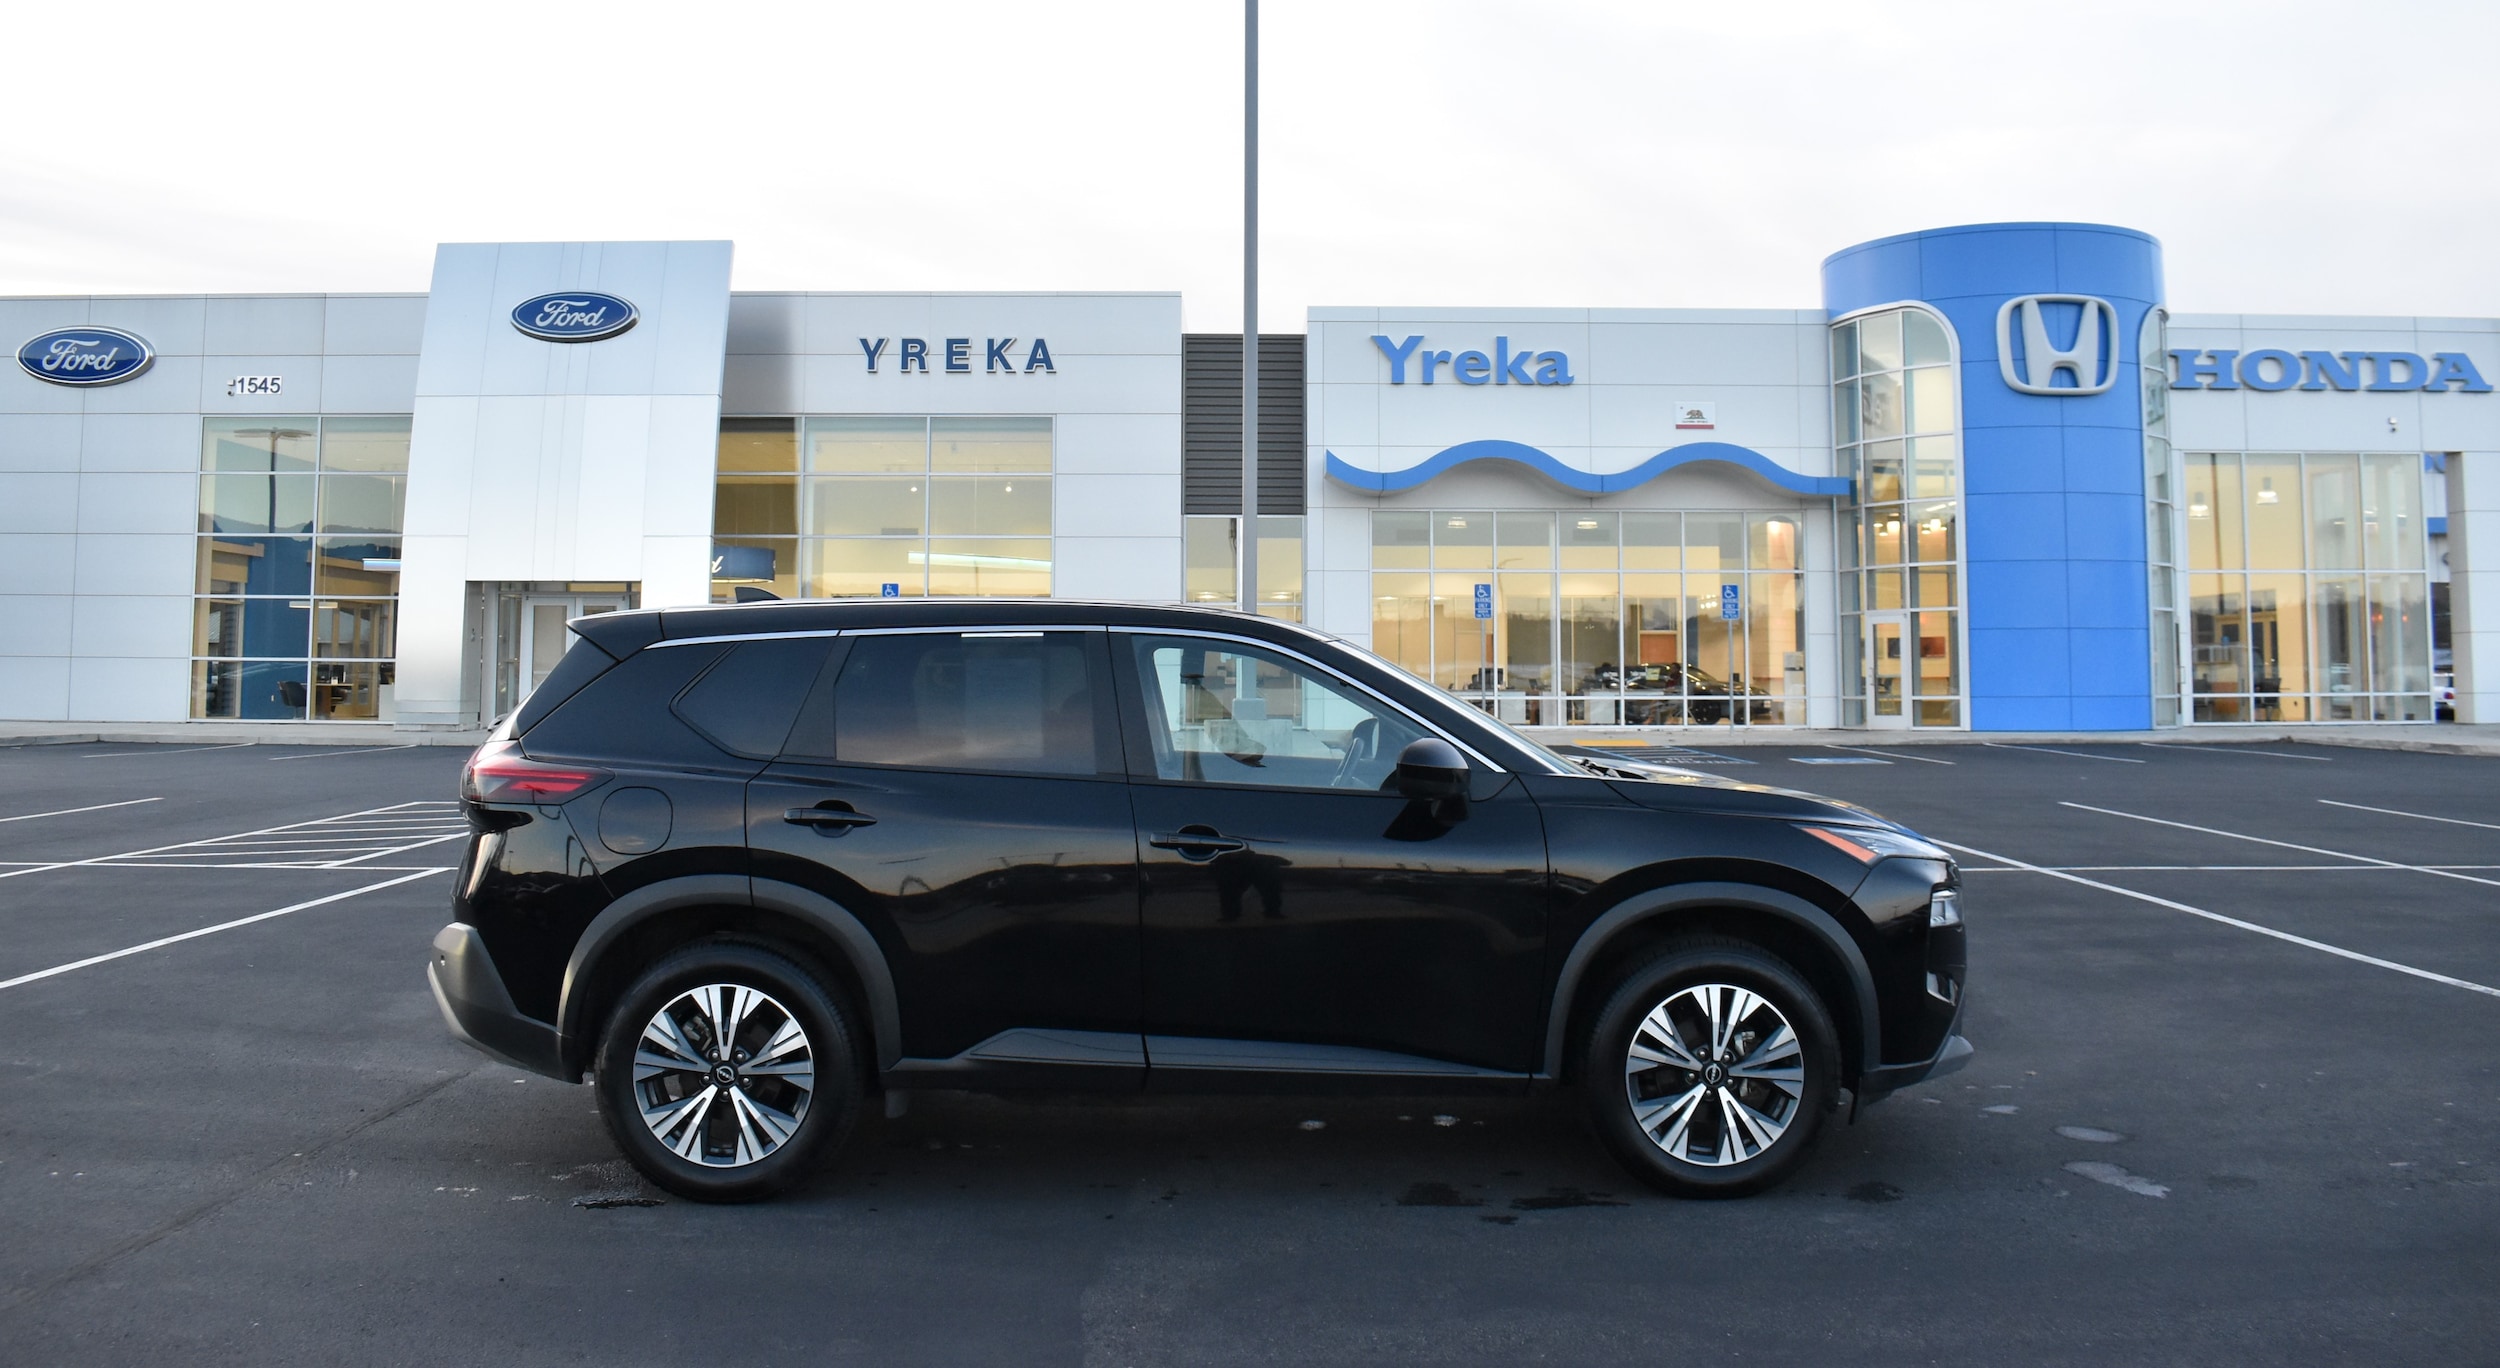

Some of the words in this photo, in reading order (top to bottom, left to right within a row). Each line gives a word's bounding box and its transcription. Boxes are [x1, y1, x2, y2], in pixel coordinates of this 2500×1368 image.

[535, 299, 607, 327] Ford
[42, 338, 119, 371] Ford
[858, 337, 1057, 373] YREKA
[1370, 335, 1575, 386] Yreka
[2168, 348, 2494, 393] HONDA
[236, 377, 281, 394] 1545
